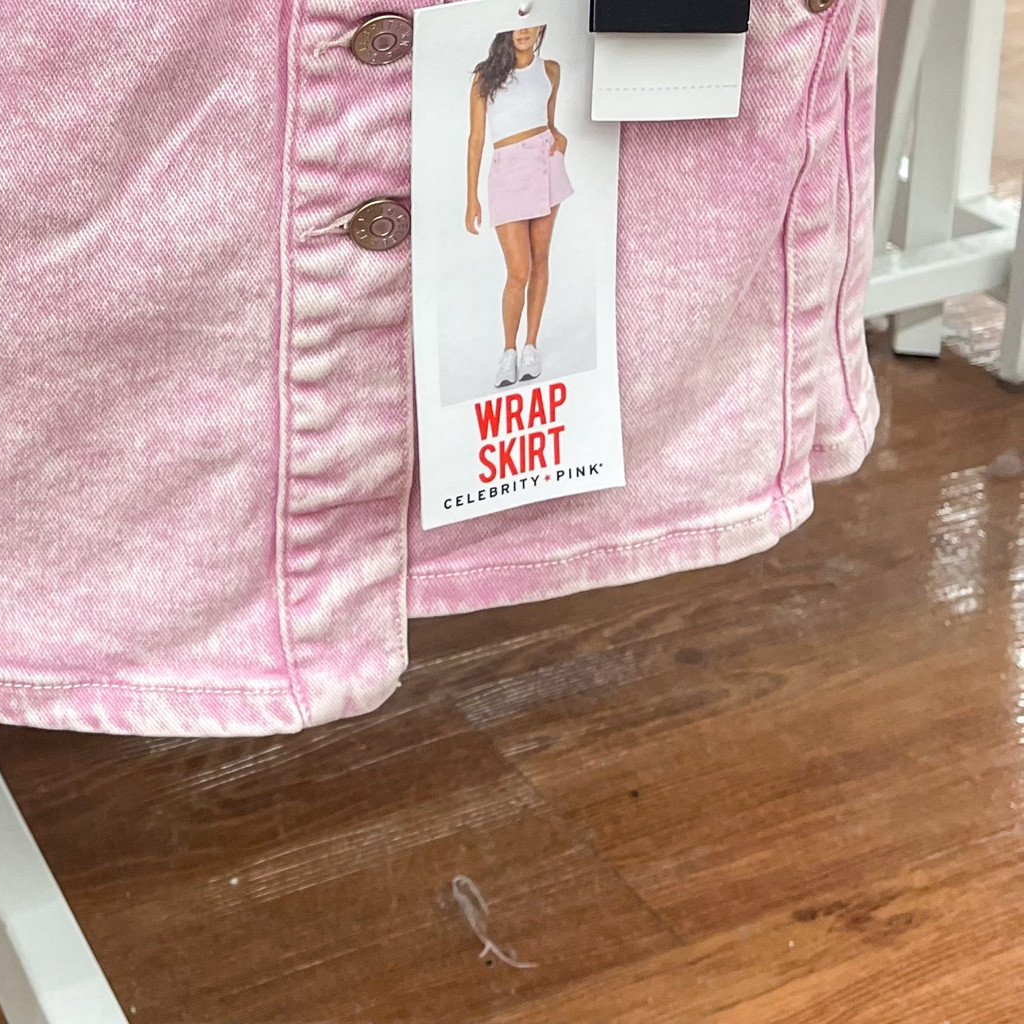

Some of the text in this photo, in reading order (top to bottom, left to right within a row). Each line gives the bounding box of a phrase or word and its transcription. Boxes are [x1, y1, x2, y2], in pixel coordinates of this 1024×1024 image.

[474, 382, 567, 440] WRAP
[478, 425, 565, 483] SKIRT
[443, 475, 540, 509] CELEBRITY
